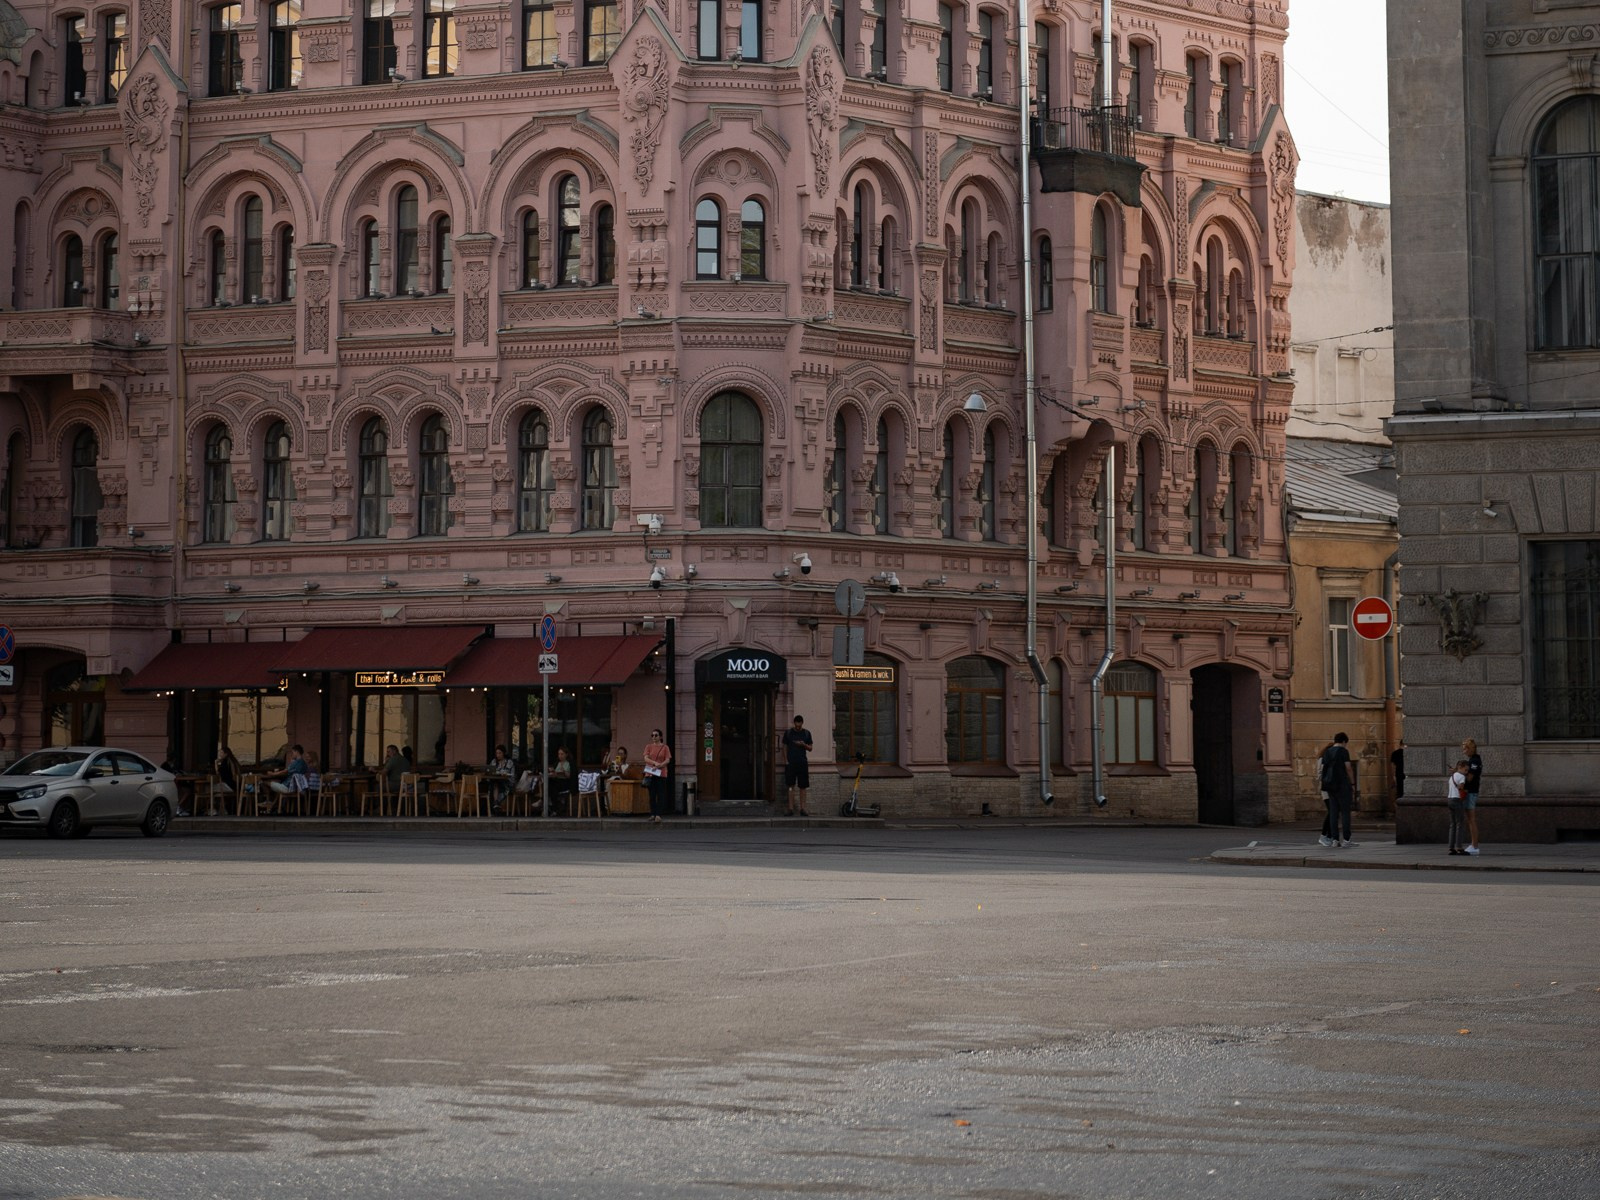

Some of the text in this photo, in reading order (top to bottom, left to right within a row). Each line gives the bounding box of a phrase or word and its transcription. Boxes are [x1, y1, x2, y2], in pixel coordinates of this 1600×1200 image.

[727, 659, 769, 671] MOJO
[360, 674, 373, 683] thai
[375, 674, 389, 683] food
[418, 673, 424, 683] &
[427, 674, 442, 683] rolls
[835, 669, 849, 678] sushi
[854, 670, 872, 679] ramen
[877, 670, 889, 679] wok
